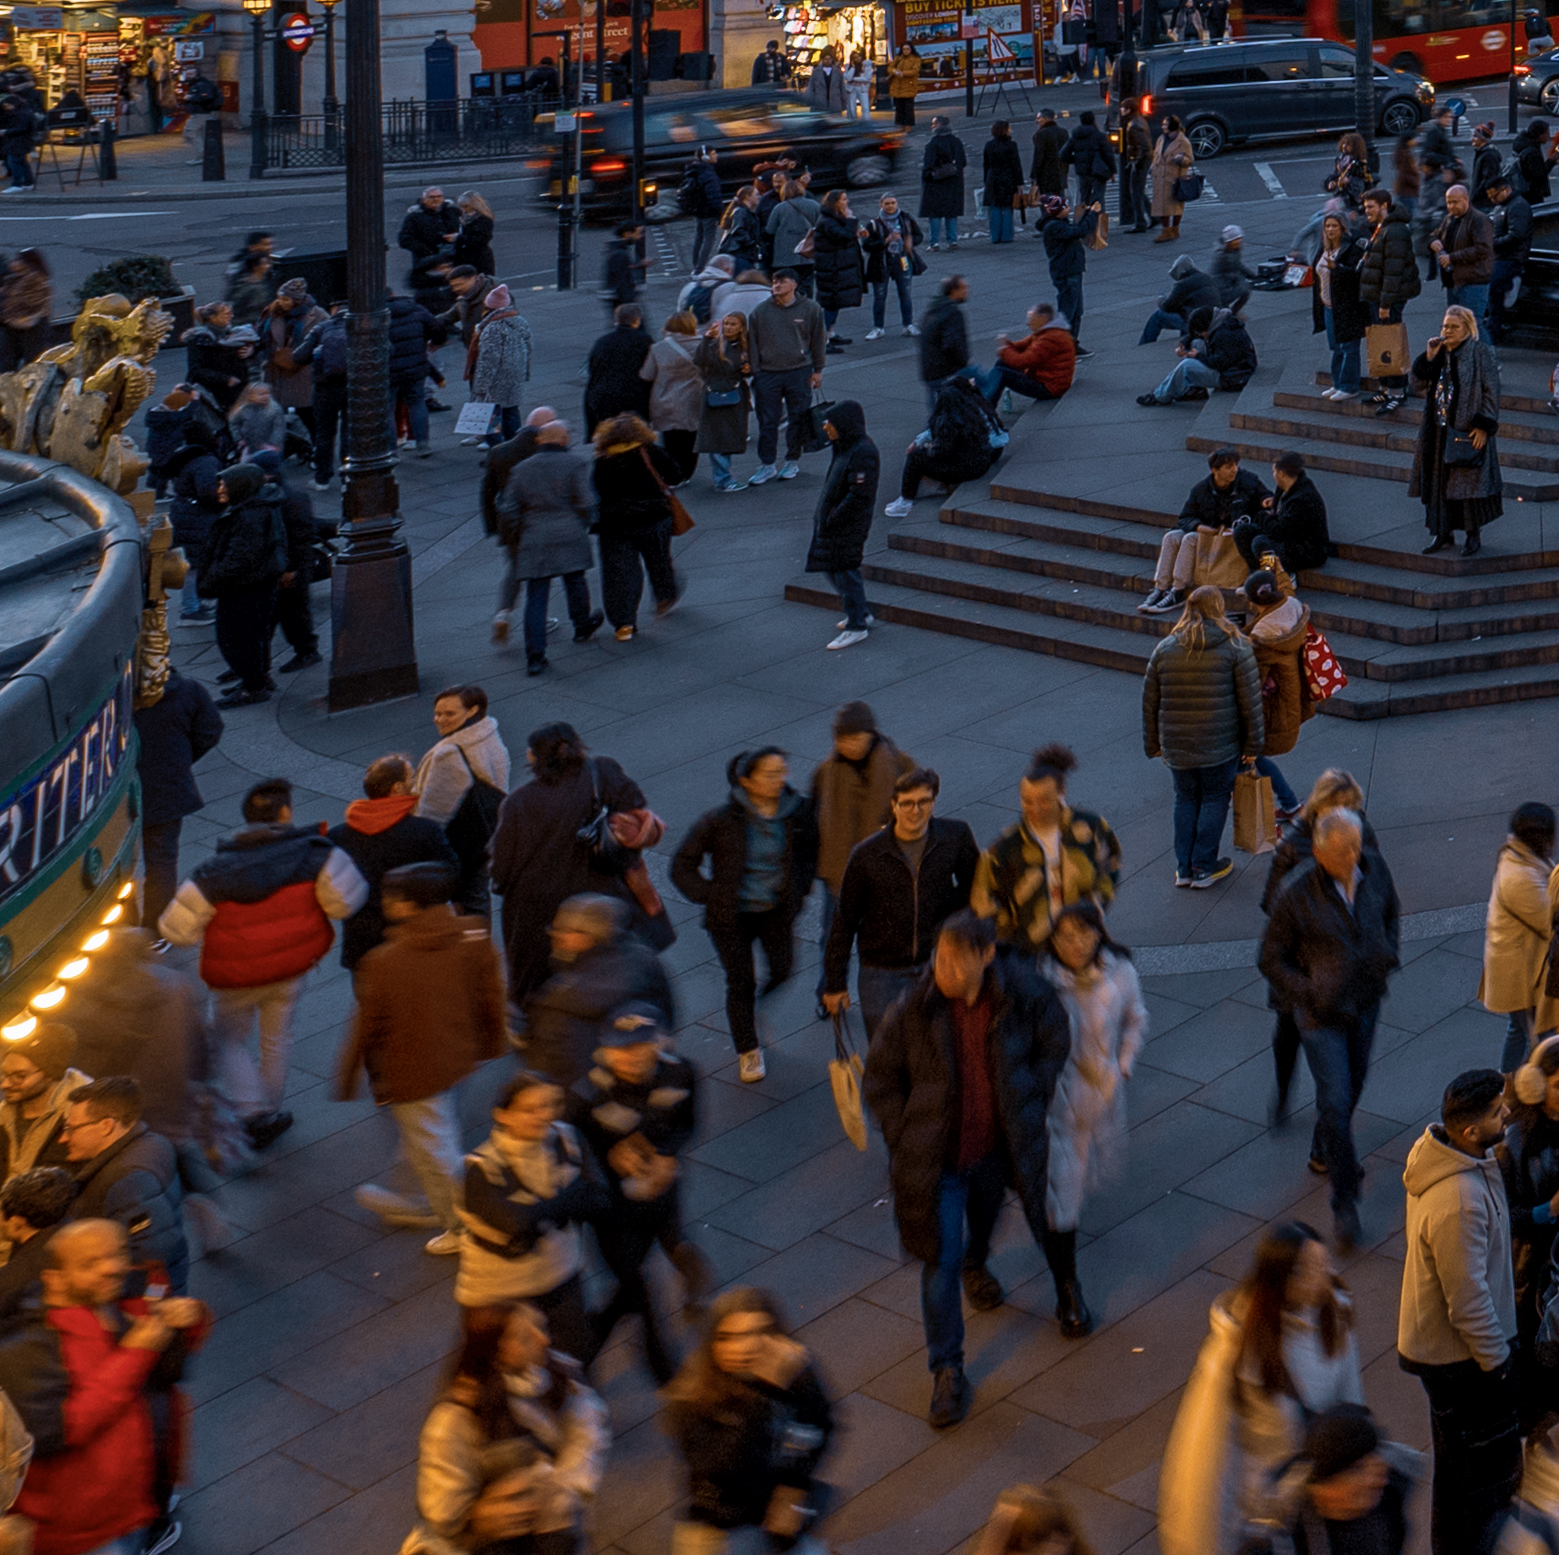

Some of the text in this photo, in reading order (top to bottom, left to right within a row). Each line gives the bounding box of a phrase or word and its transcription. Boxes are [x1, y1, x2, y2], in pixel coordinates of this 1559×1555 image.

[905, 2, 931, 14] BUY
[934, 10, 958, 19] LONDON
[283, 27, 314, 37] UNDERGROUND
[603, 27, 629, 38] treet
